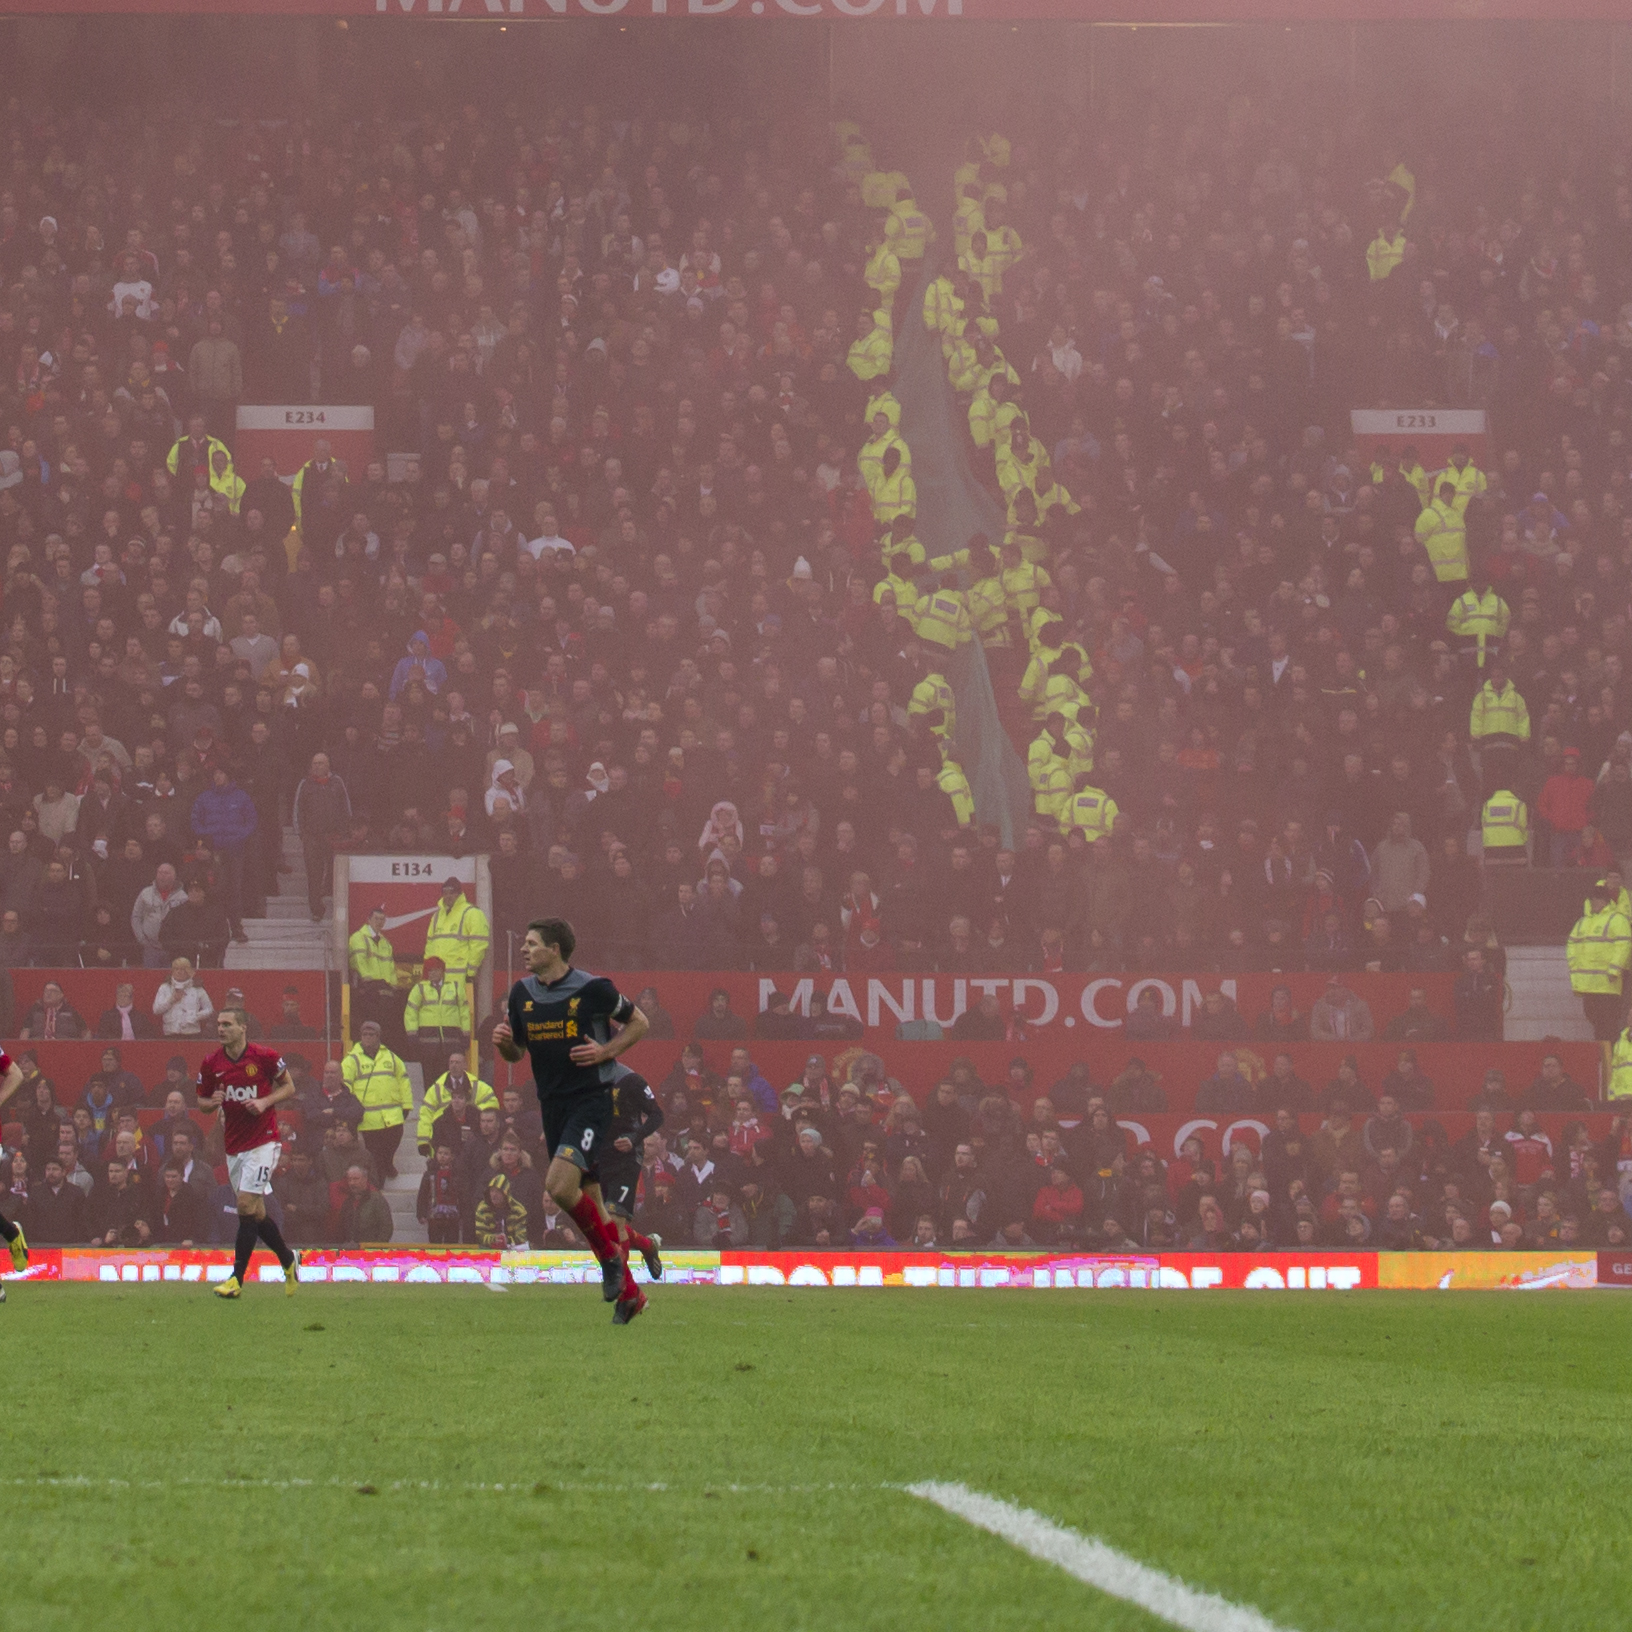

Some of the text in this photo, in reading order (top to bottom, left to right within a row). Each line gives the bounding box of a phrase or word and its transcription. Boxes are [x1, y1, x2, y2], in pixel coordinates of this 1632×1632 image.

[284, 411, 326, 424] E234
[1396, 415, 1437, 428] E233
[391, 862, 433, 876] E134
[527, 1020, 564, 1031] Standard
[225, 1084, 258, 1102] AON
[580, 1128, 595, 1152] 8
[257, 1166, 270, 1183] 15
[618, 1185, 630, 1203] 7
